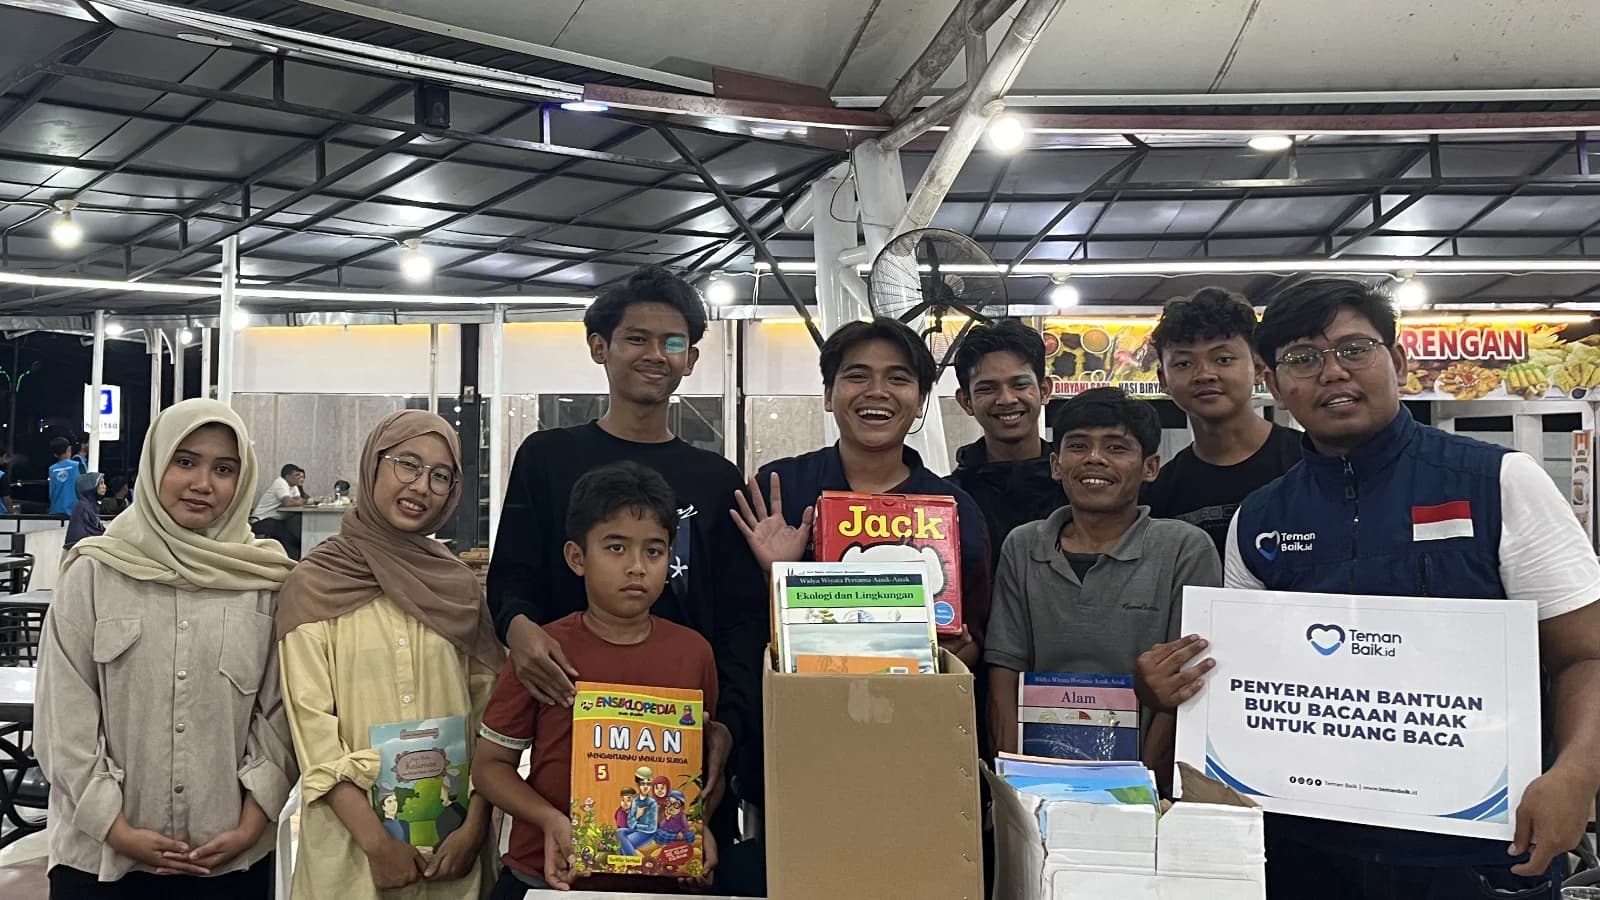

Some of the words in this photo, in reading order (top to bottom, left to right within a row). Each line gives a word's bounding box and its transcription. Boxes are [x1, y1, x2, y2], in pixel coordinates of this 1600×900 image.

[838, 505, 946, 540] Jack
[1280, 532, 1316, 542] Teman
[796, 591, 833, 601] Ekologi
[834, 591, 853, 600] dan
[855, 590, 914, 600] Lingkungan
[1348, 629, 1402, 644] Teman
[1351, 643, 1396, 657] Baik.id
[1061, 691, 1096, 704] Alam
[1230, 678, 1371, 703] PENYERAHAN
[1376, 690, 1483, 711] BANTUAN
[594, 696, 677, 715] ENSIKLOPEDIA
[1244, 697, 1301, 715] BUKU
[1307, 703, 1397, 724] BACAAN
[1403, 711, 1467, 729] ANAK
[593, 724, 682, 754] IMAN
[1246, 715, 1317, 735] UNTUK
[1322, 723, 1397, 742] RUANG
[1403, 729, 1465, 748] BACA
[597, 765, 607, 780] 5
